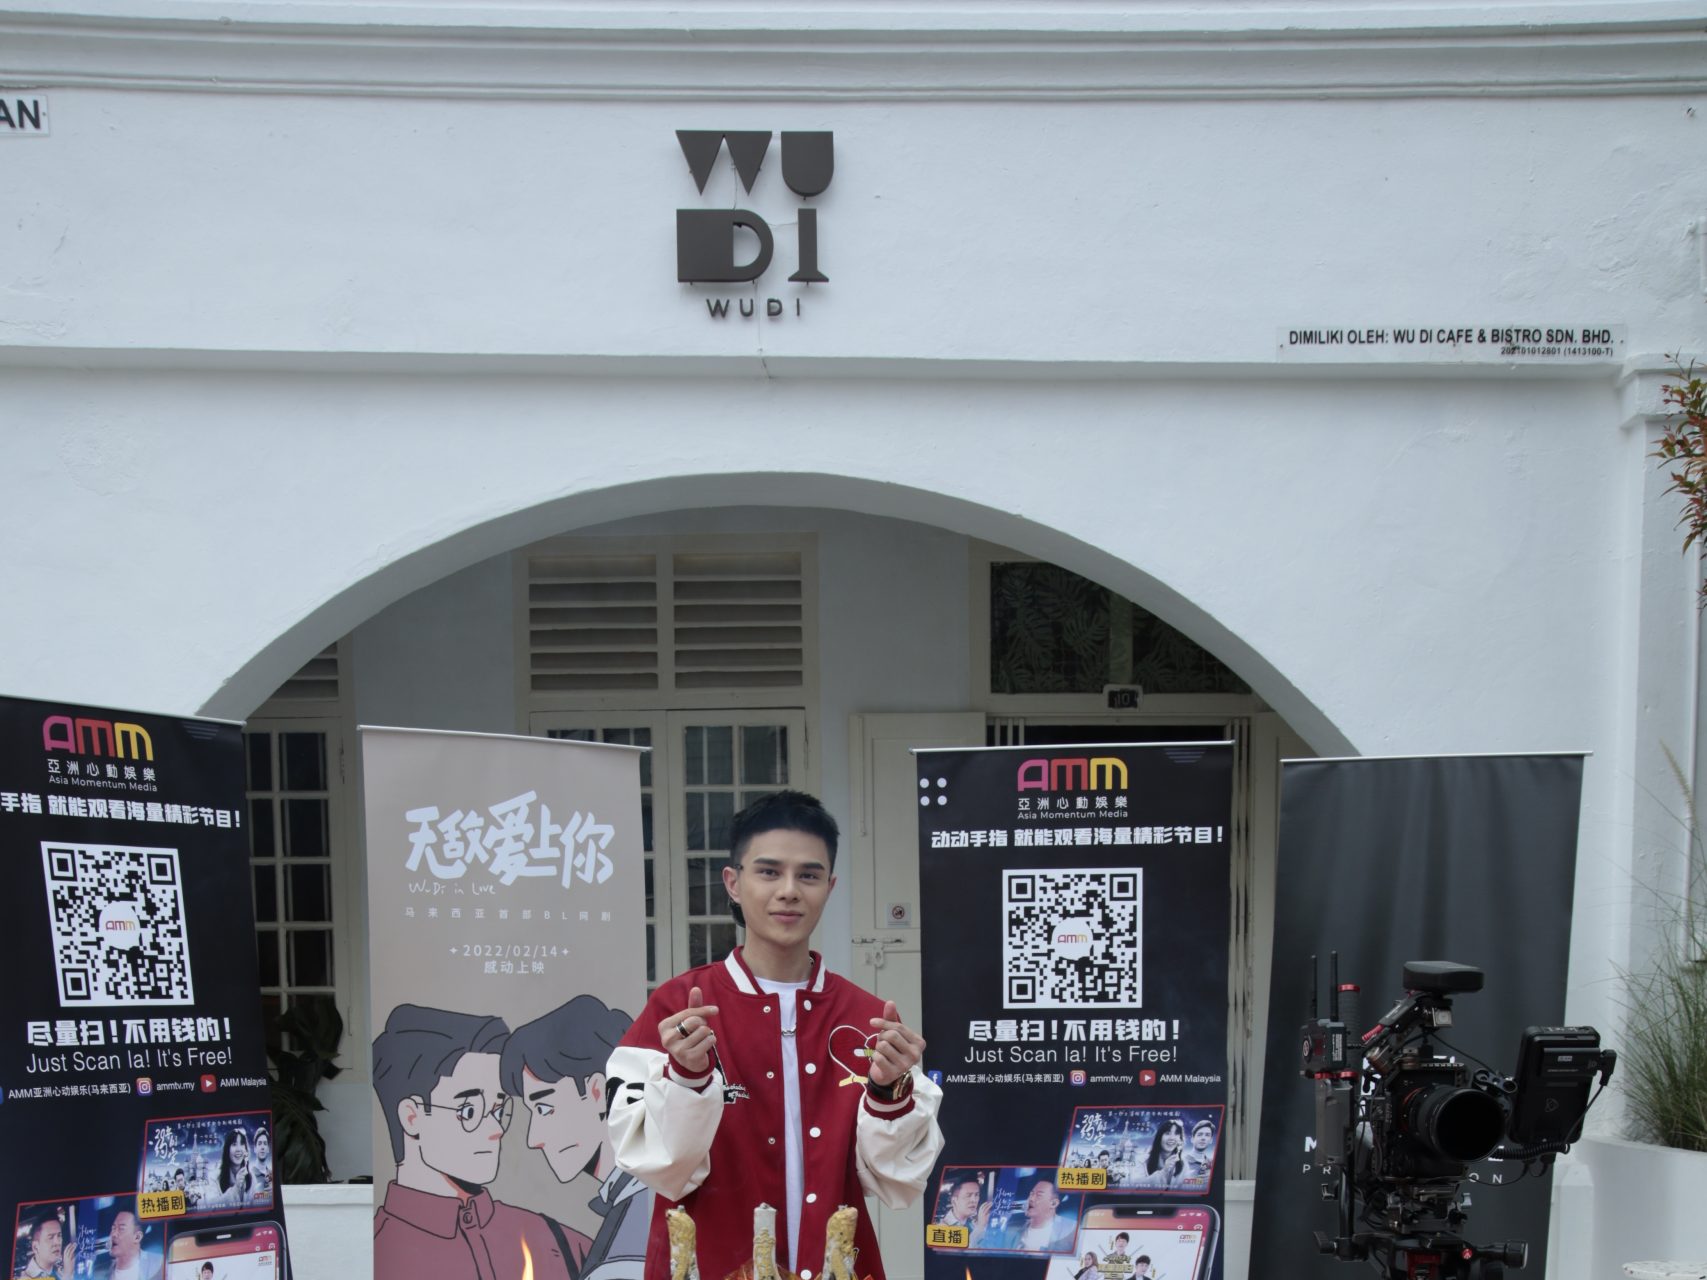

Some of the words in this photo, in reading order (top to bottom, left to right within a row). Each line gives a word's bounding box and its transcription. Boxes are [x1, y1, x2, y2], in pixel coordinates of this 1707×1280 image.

[676, 130, 834, 197] WU
[676, 208, 830, 283] DI
[706, 298, 800, 318] WUDI
[1289, 331, 1343, 344] DIMILIKI
[1348, 330, 1389, 344] OLEH:
[1393, 330, 1414, 343] WU
[1419, 330, 1432, 343] DI
[1436, 330, 1473, 343] CAFE
[1478, 330, 1486, 343] &
[1491, 330, 1542, 343] BISTRO
[1546, 330, 1577, 343] SDN.
[1582, 330, 1614, 343] BHD.
[49, 775, 69, 785] Asia
[71, 777, 126, 790] Momentum
[129, 782, 157, 792] Media
[1, 791, 43, 814] 手指
[48, 794, 240, 828] 就能观看海量精彩节目!
[1017, 811, 1037, 820] Asia
[1040, 811, 1096, 819] Momentum
[1099, 809, 1128, 818] Media
[931, 829, 1008, 849] 动动手指
[1014, 826, 1223, 847] 就能观看海量精彩节目!
[463, 944, 558, 959] 2022/02/14
[484, 961, 545, 975] 感动上映
[26, 1052, 68, 1073] Just
[72, 1051, 121, 1072] Scan
[128, 1050, 151, 1069] la!
[157, 1049, 182, 1067] It's
[188, 1046, 232, 1066] Free!
[964, 1047, 1004, 1063] Just
[1009, 1046, 1057, 1063] Scan
[1064, 1046, 1087, 1062] la!
[1096, 1046, 1122, 1062] It's
[1130, 1046, 1177, 1062] Free!
[220, 1078, 239, 1087] AMM
[240, 1078, 267, 1088] Malaysia
[1090, 1074, 1133, 1084] ammtv.my
[1159, 1074, 1182, 1083] AMM
[1184, 1073, 1221, 1083] Malaysia
[156, 1081, 195, 1092] ammtv.my
[1060, 1171, 1105, 1186] 热播剧
[141, 1194, 184, 1214] 热播剧
[931, 1229, 962, 1244] 直播
